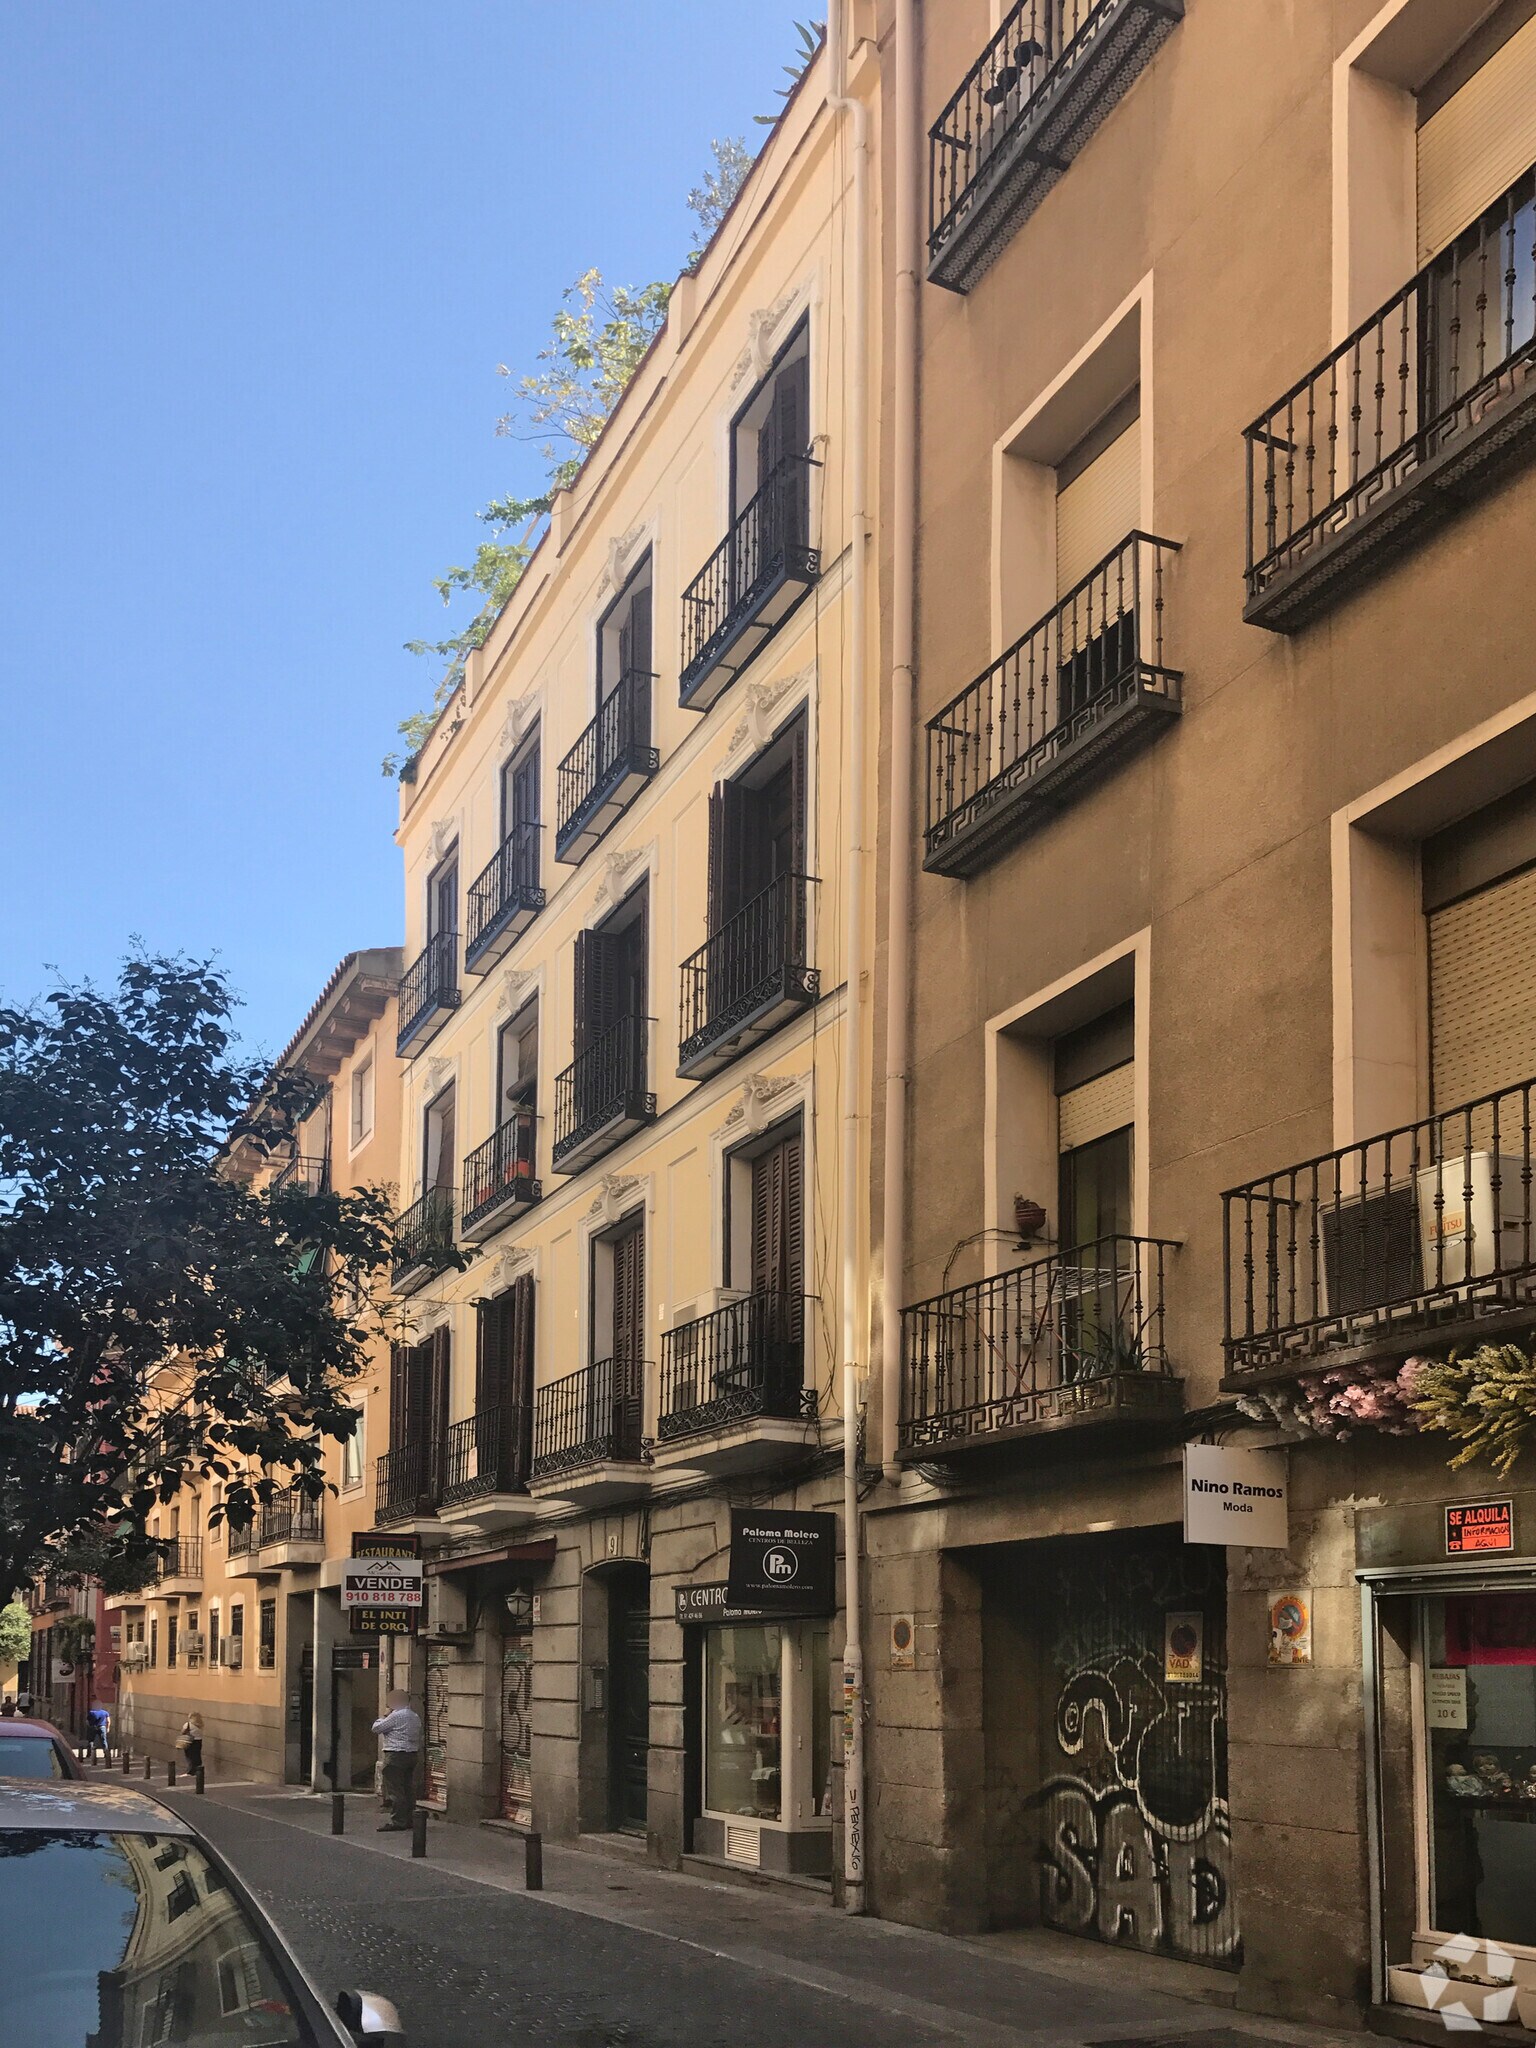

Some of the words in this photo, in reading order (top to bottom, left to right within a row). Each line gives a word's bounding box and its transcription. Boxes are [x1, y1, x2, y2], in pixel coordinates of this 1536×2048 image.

[1430, 1218, 1462, 1235] FUITSU
[1191, 1479, 1229, 1494] Nino
[1232, 1482, 1283, 1498] Ramos
[1223, 1502, 1253, 1512] Moda
[1449, 1511, 1462, 1526] SE
[1465, 1506, 1509, 1524] ALQUILA
[742, 1527, 781, 1537] Paloma
[784, 1529, 819, 1539] Molero
[610, 1537, 614, 1553] 9
[355, 1578, 413, 1590] VENDE
[346, 1592, 369, 1601] 910
[373, 1593, 395, 1602] 818
[399, 1593, 421, 1602] 788
[380, 1611, 406, 1619] INTI
[361, 1622, 376, 1630] DE
[380, 1623, 406, 1631] ORO
[1169, 1659, 1194, 1669] VAD
[1437, 1709, 1448, 1718] 10
[1451, 1709, 1457, 1718] €
